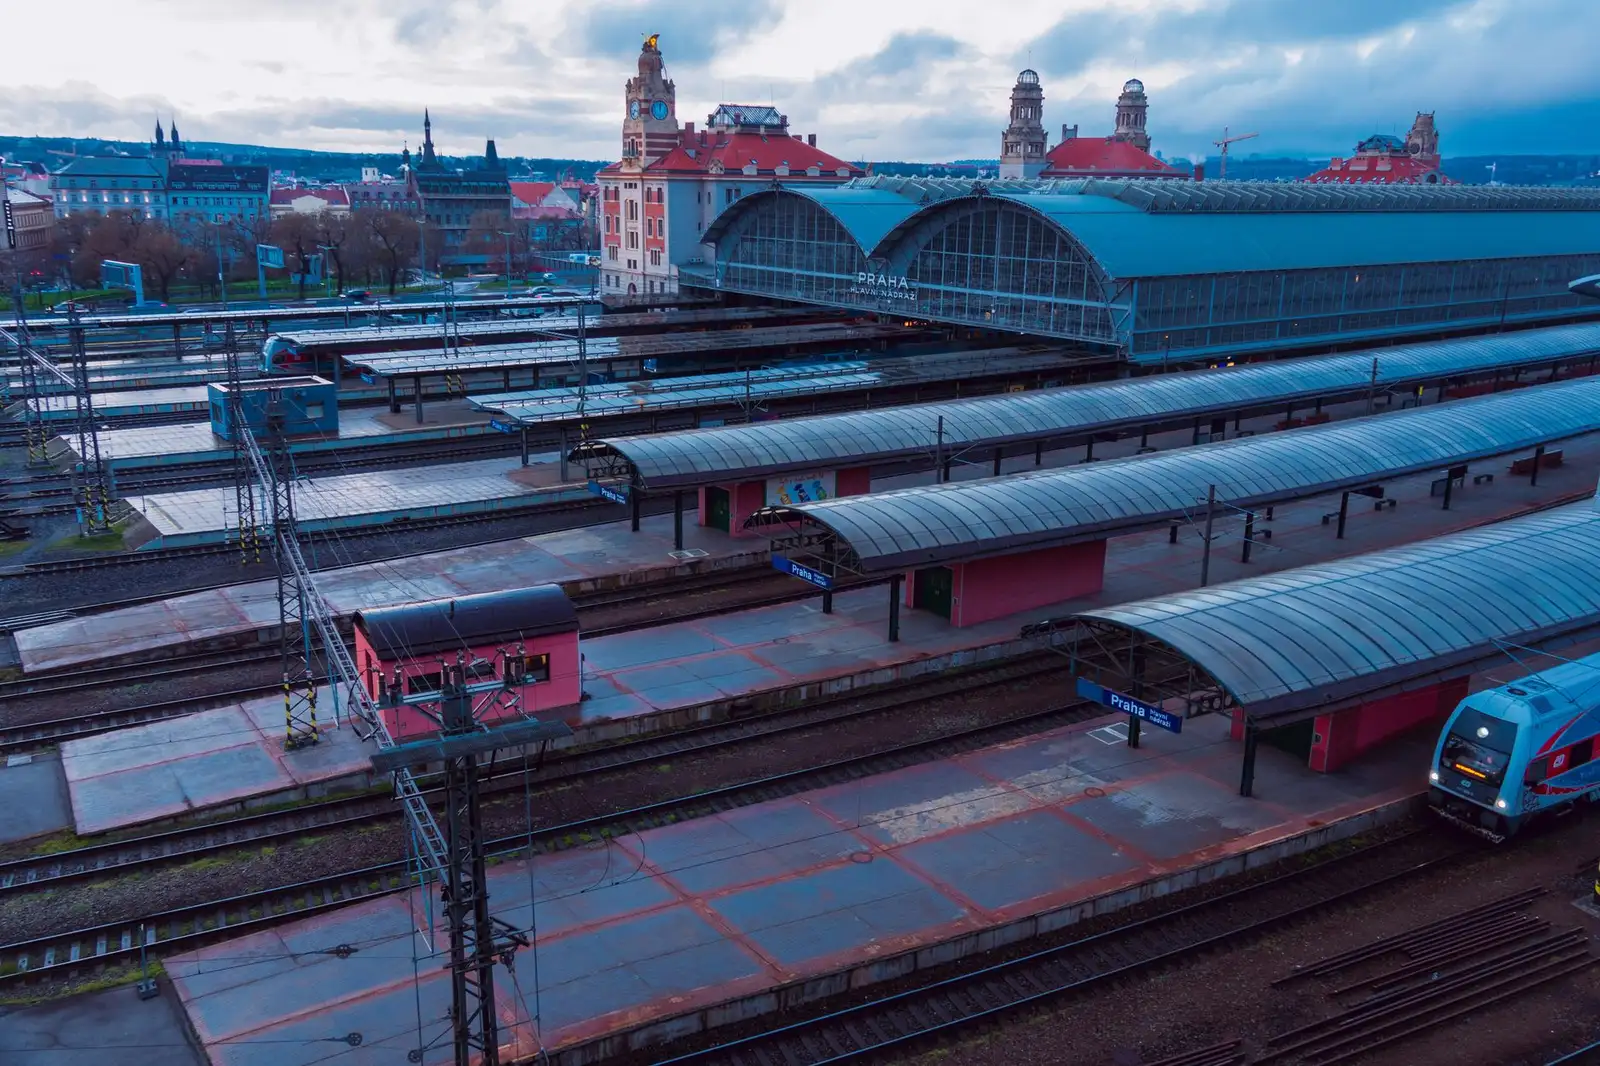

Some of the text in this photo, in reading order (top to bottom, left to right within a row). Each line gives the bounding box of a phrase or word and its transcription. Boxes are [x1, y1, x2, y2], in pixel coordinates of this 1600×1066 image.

[858, 272, 909, 289] PRAHA
[792, 563, 812, 580] Praha
[1111, 693, 1146, 717] Praha
